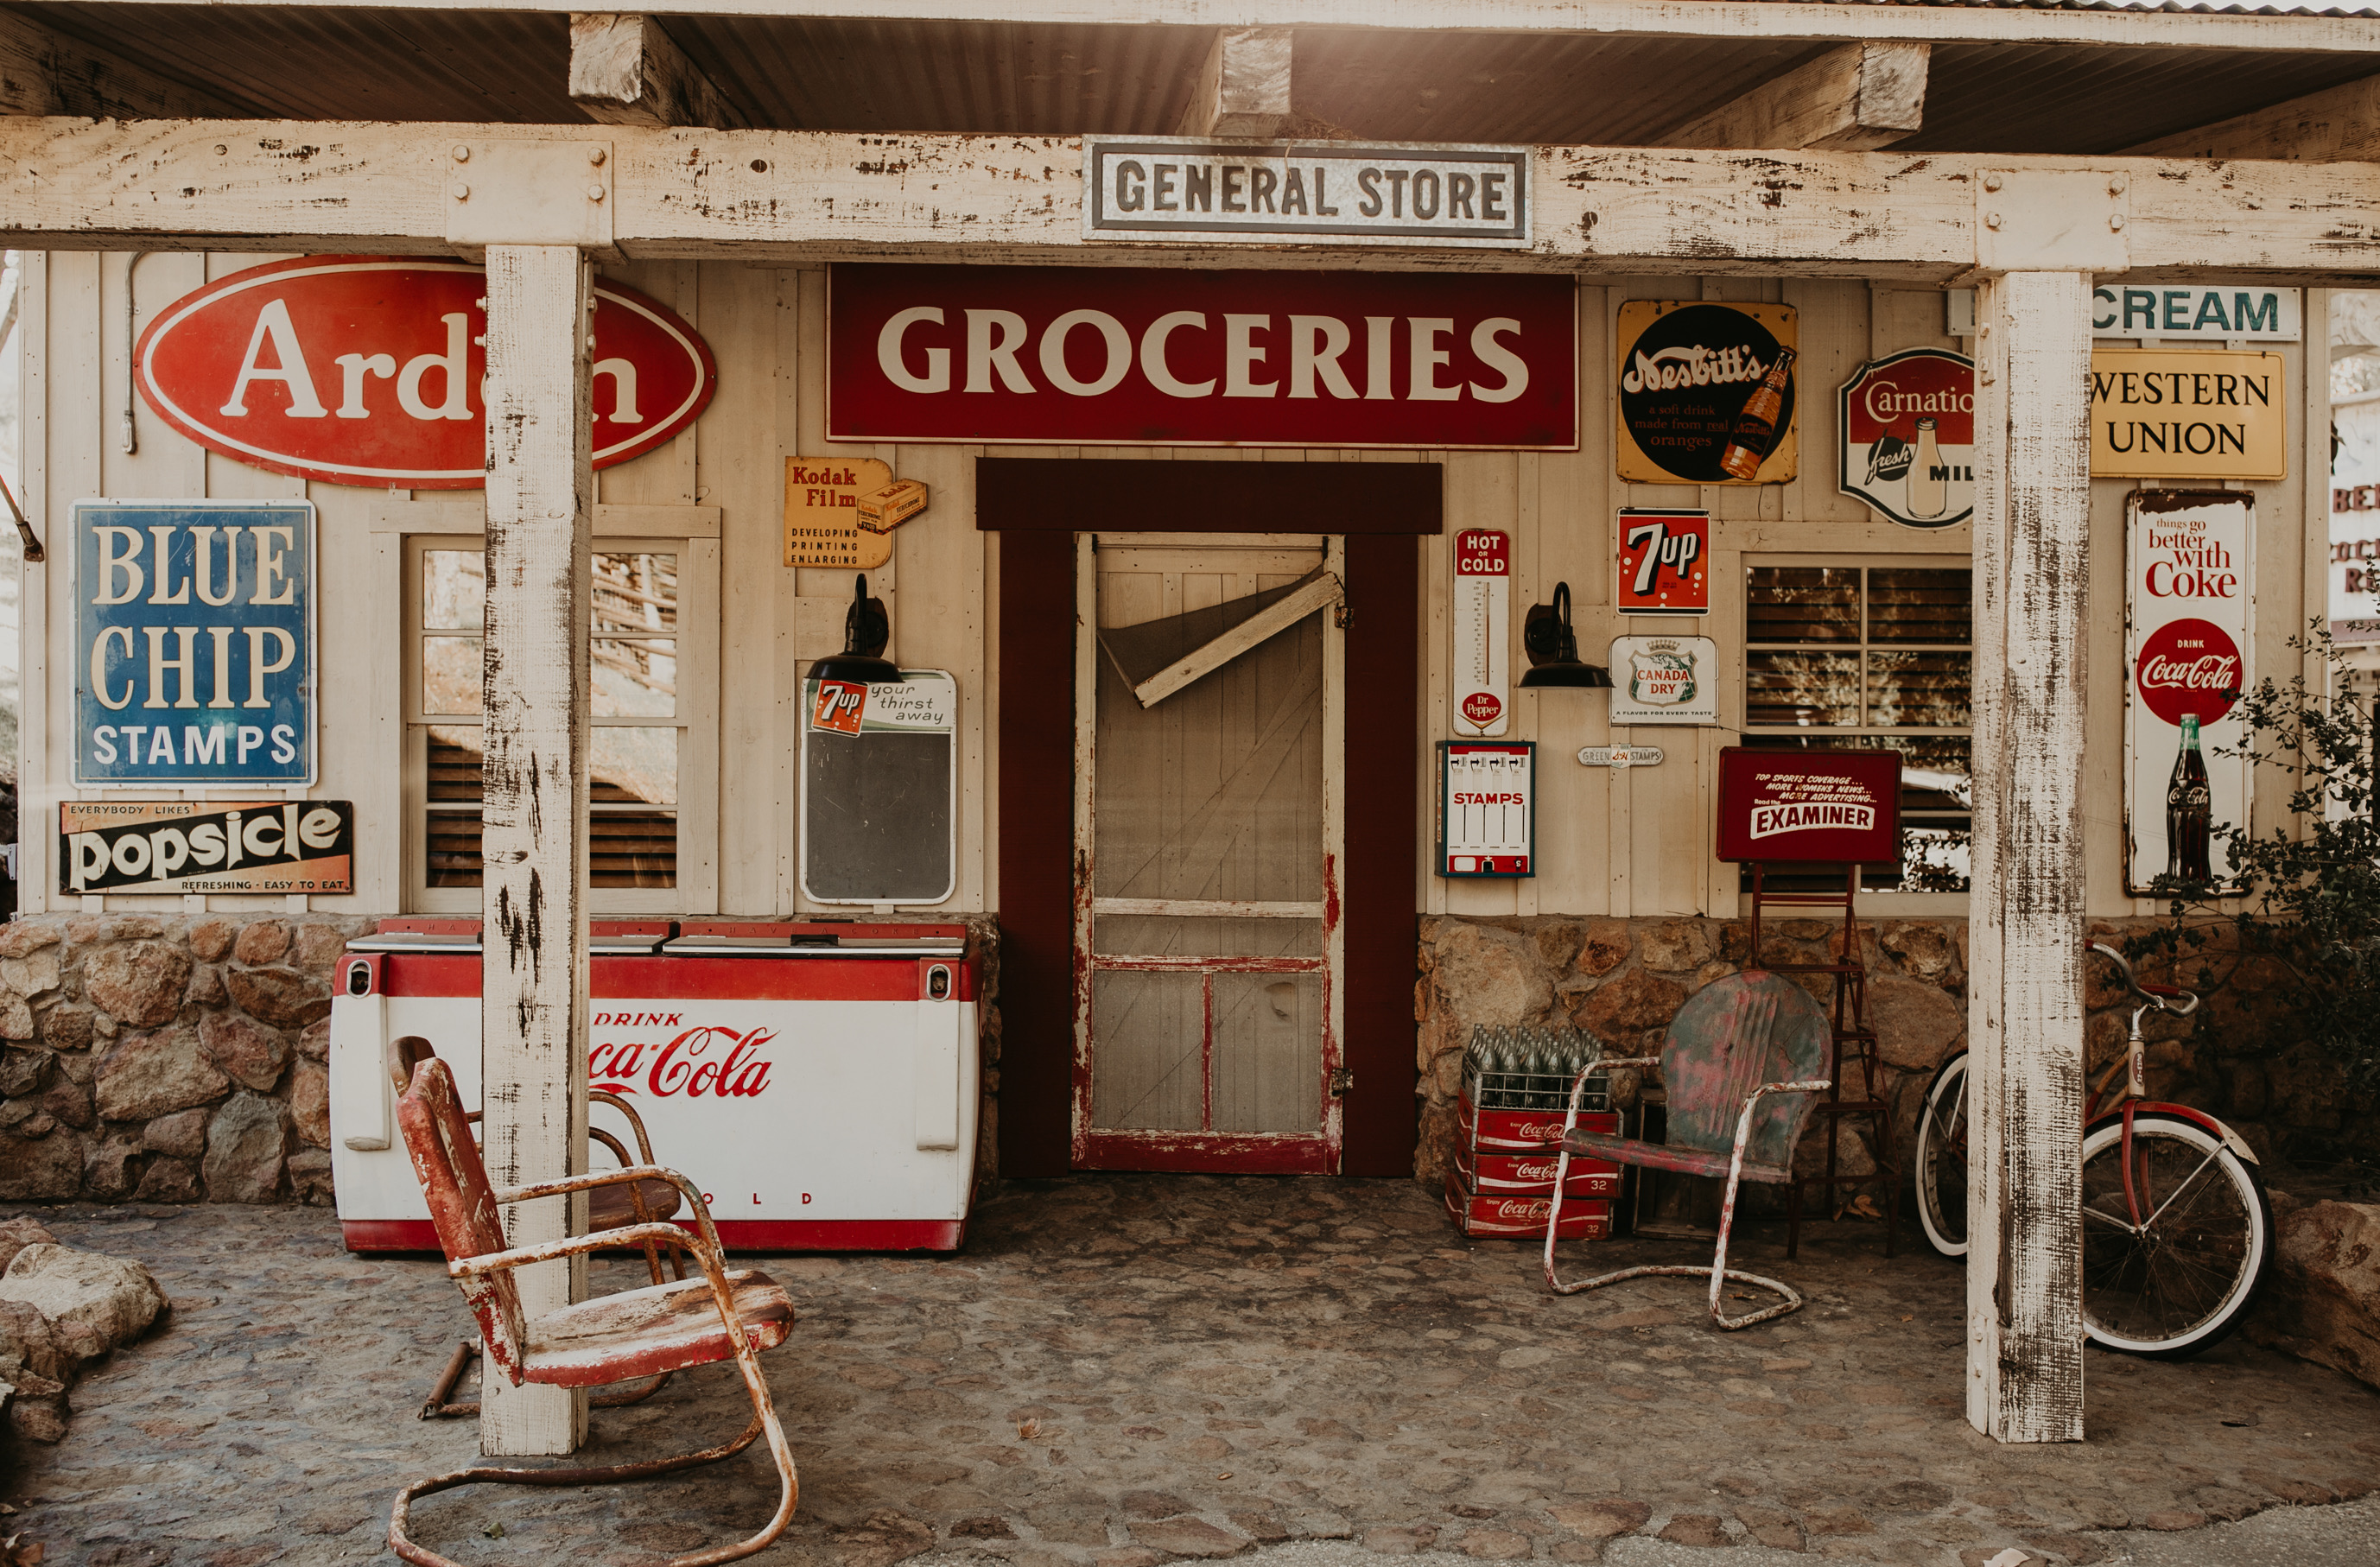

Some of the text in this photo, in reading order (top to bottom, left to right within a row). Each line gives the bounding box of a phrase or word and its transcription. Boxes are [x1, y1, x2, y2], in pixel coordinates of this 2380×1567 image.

[1116, 159, 1507, 221] GENERAL STORE
[2092, 288, 2279, 332] CREAM
[219, 298, 644, 423] Ardn
[877, 306, 1529, 403] GROCERIES
[1623, 344, 1770, 394] Nesbitt's
[2091, 371, 2270, 408] WESTERN
[1649, 403, 1716, 416] a soft drink
[1865, 380, 1974, 423] Carnatio
[1635, 418, 1728, 429] made from real
[1650, 435, 1712, 451] oranges
[2106, 421, 2245, 455] UNION
[1864, 428, 1910, 485] fresh
[792, 466, 857, 485] Kodak
[1929, 466, 1974, 481] MIL
[806, 489, 856, 507] Film
[2333, 484, 2380, 513] BE
[791, 528, 858, 537] DEVELOPING
[2156, 518, 2206, 532] things go
[791, 542, 858, 551] PRINTING
[1467, 536, 1501, 549] HOT
[2148, 529, 2206, 549] better
[1628, 522, 1699, 594] 7up
[2173, 541, 2231, 569] with
[2330, 538, 2380, 564] OC
[92, 525, 295, 606] BLUE
[790, 555, 858, 564] ENLARGING
[1461, 558, 1505, 573] COLD
[2145, 561, 2237, 598] Coke
[2177, 639, 2205, 649] DRINK
[90, 626, 296, 710] CHIP
[1637, 669, 1689, 681] CANADA
[2141, 654, 2238, 689] Coca-Cola
[871, 686, 916, 698] your
[1650, 683, 1677, 695] DRY
[821, 684, 860, 720] 7up
[879, 695, 934, 709] thirst
[1476, 695, 1489, 706] Dr
[1466, 703, 1499, 717] Pepper
[895, 712, 944, 725] away
[92, 724, 296, 765] STAMPS
[1583, 752, 1610, 761] GREEN
[1630, 751, 1660, 761] STAMPS
[1772, 774, 1805, 783] SPORTS
[1766, 783, 1792, 791] MORE
[1795, 784, 1832, 793] WOMENS
[1453, 792, 1524, 805] STAMPS
[70, 804, 191, 815] EVERYBODY LIKES
[1756, 805, 1870, 834] EXAMINER
[69, 803, 342, 891] popsicle
[181, 879, 252, 891] REFRESHING
[264, 880, 294, 890] EASY
[299, 880, 315, 890] TO
[321, 880, 345, 890] EAT
[428, 923, 477, 931] HAV
[593, 1012, 683, 1026] DRINK
[589, 1026, 781, 1097] ca-Cola
[1519, 1122, 1564, 1139] Coca-Col
[1516, 1161, 1558, 1178] Coca-Co
[1590, 1180, 1607, 1190] 32
[702, 1192, 812, 1205] OLD
[1498, 1199, 1552, 1219] Coca-Col
[1587, 1224, 1599, 1234] 32
